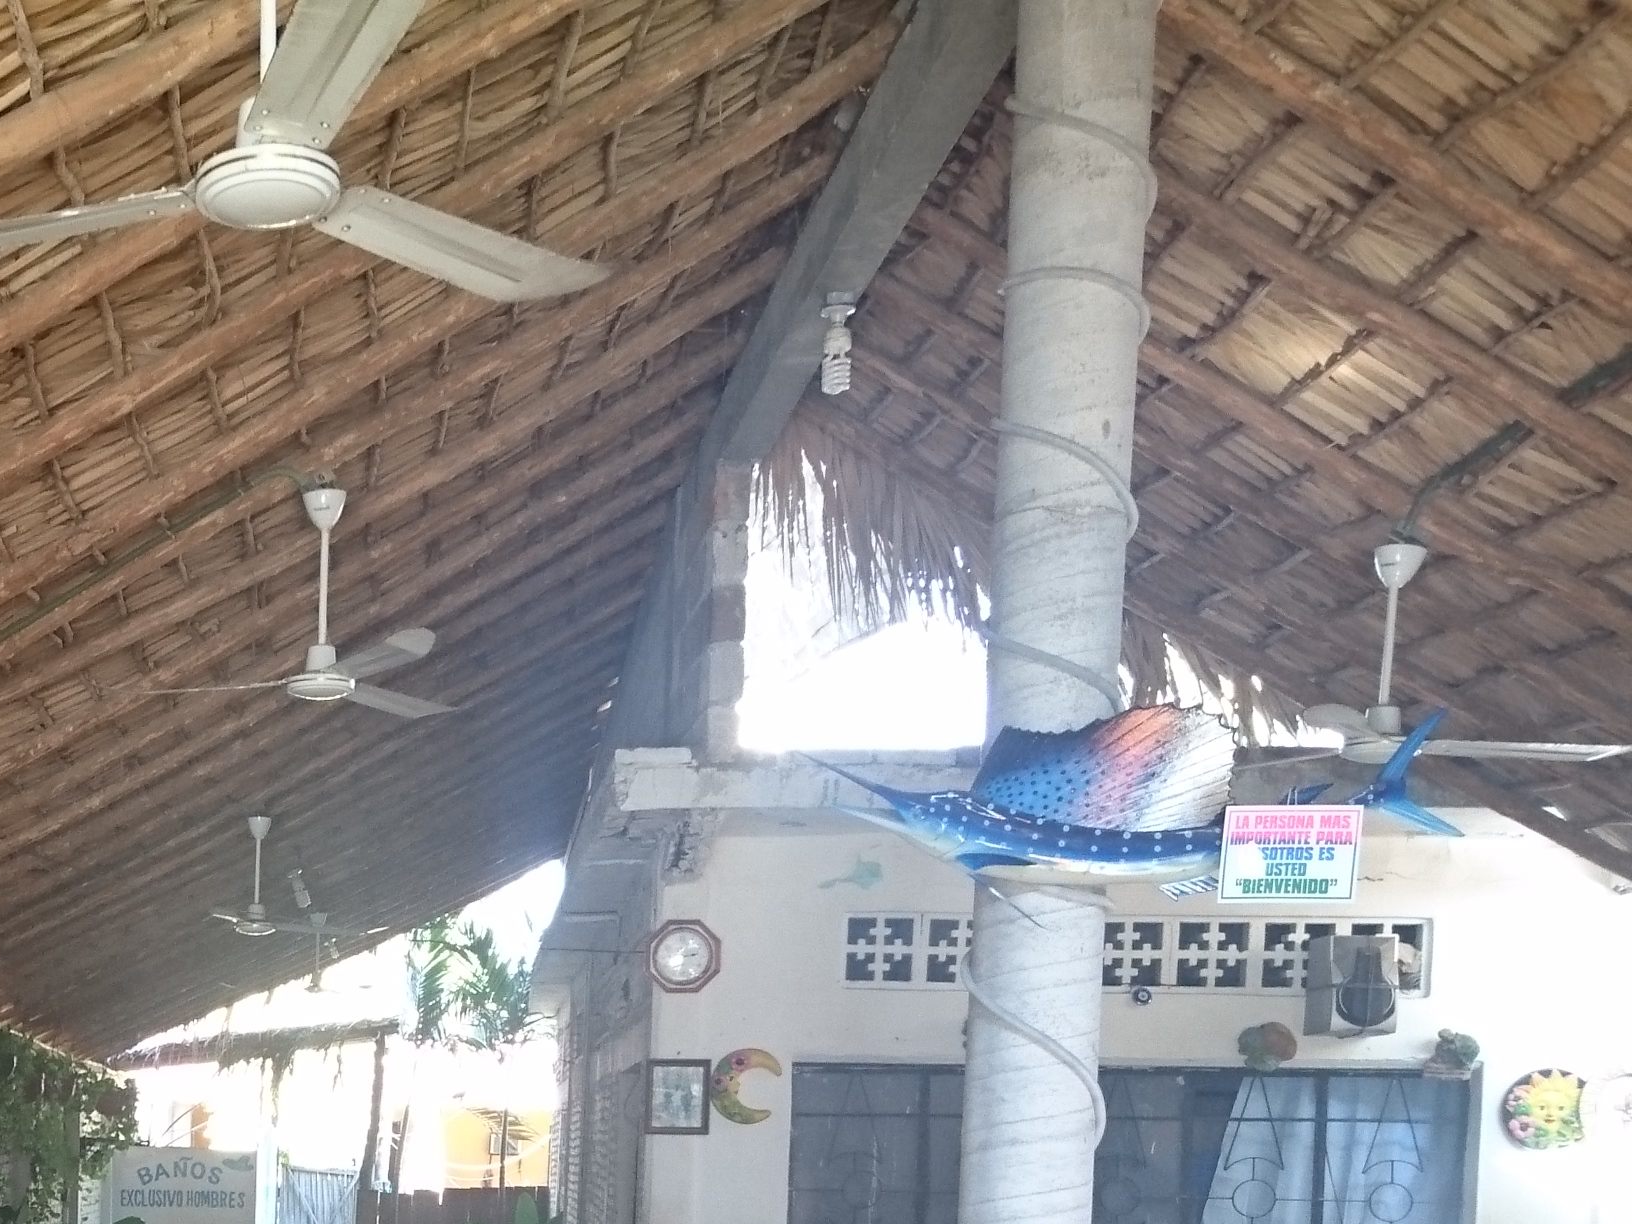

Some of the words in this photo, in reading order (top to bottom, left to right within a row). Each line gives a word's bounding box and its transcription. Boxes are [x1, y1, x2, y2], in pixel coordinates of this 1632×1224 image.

[1235, 815, 1250, 829] LA
[1254, 815, 1314, 829] PERSONA
[1319, 815, 1352, 829] MAS
[1230, 831, 1311, 846] IMPORTANTE
[1315, 831, 1353, 845] PARA
[1256, 846, 1314, 861] SOTROS
[1318, 846, 1336, 861] ES
[1265, 862, 1308, 877] USTED
[136, 1156, 224, 1186] BAÑOS
[120, 1189, 184, 1208] EXCLUSIVO
[186, 1190, 246, 1209] HOMBRES
